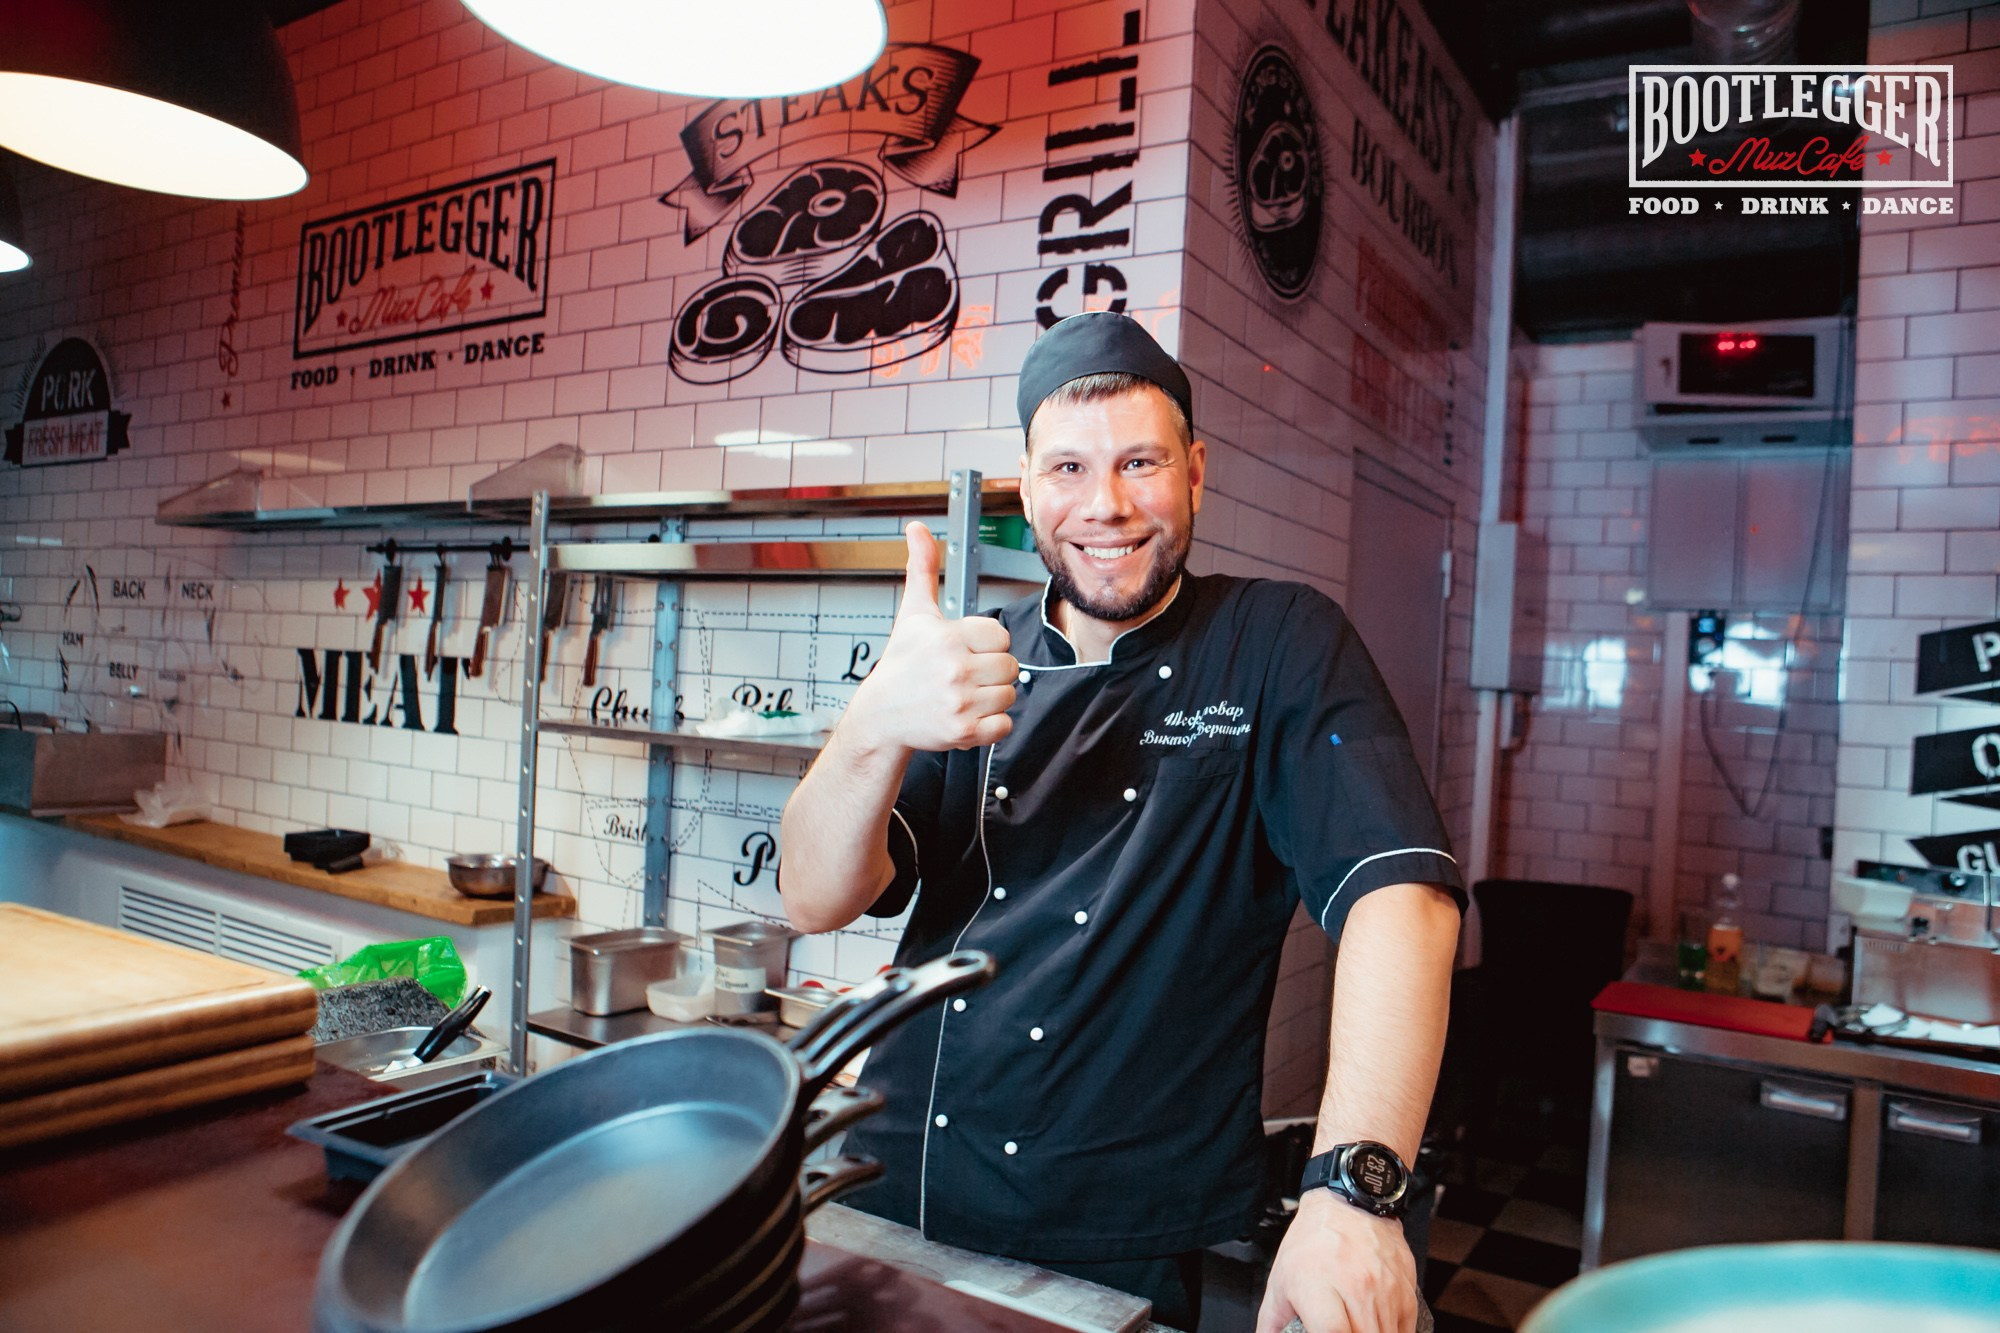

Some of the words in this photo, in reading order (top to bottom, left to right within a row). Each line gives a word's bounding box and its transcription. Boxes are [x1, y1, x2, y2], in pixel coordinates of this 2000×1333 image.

[714, 65, 934, 158] STEAKS
[1036, 10, 1140, 329] GRILL
[303, 177, 543, 337] BOOTLEGGER
[291, 366, 338, 390] FOOD
[369, 350, 436, 378] DRINK
[464, 332, 545, 364] DANCE
[28, 424, 64, 457] FRESH
[68, 419, 102, 454] MEAT
[112, 579, 146, 599] BACK
[181, 582, 214, 601] NECK
[109, 662, 139, 680] BELLY
[296, 648, 470, 735] MEAT
[591, 686, 684, 721] Chuk
